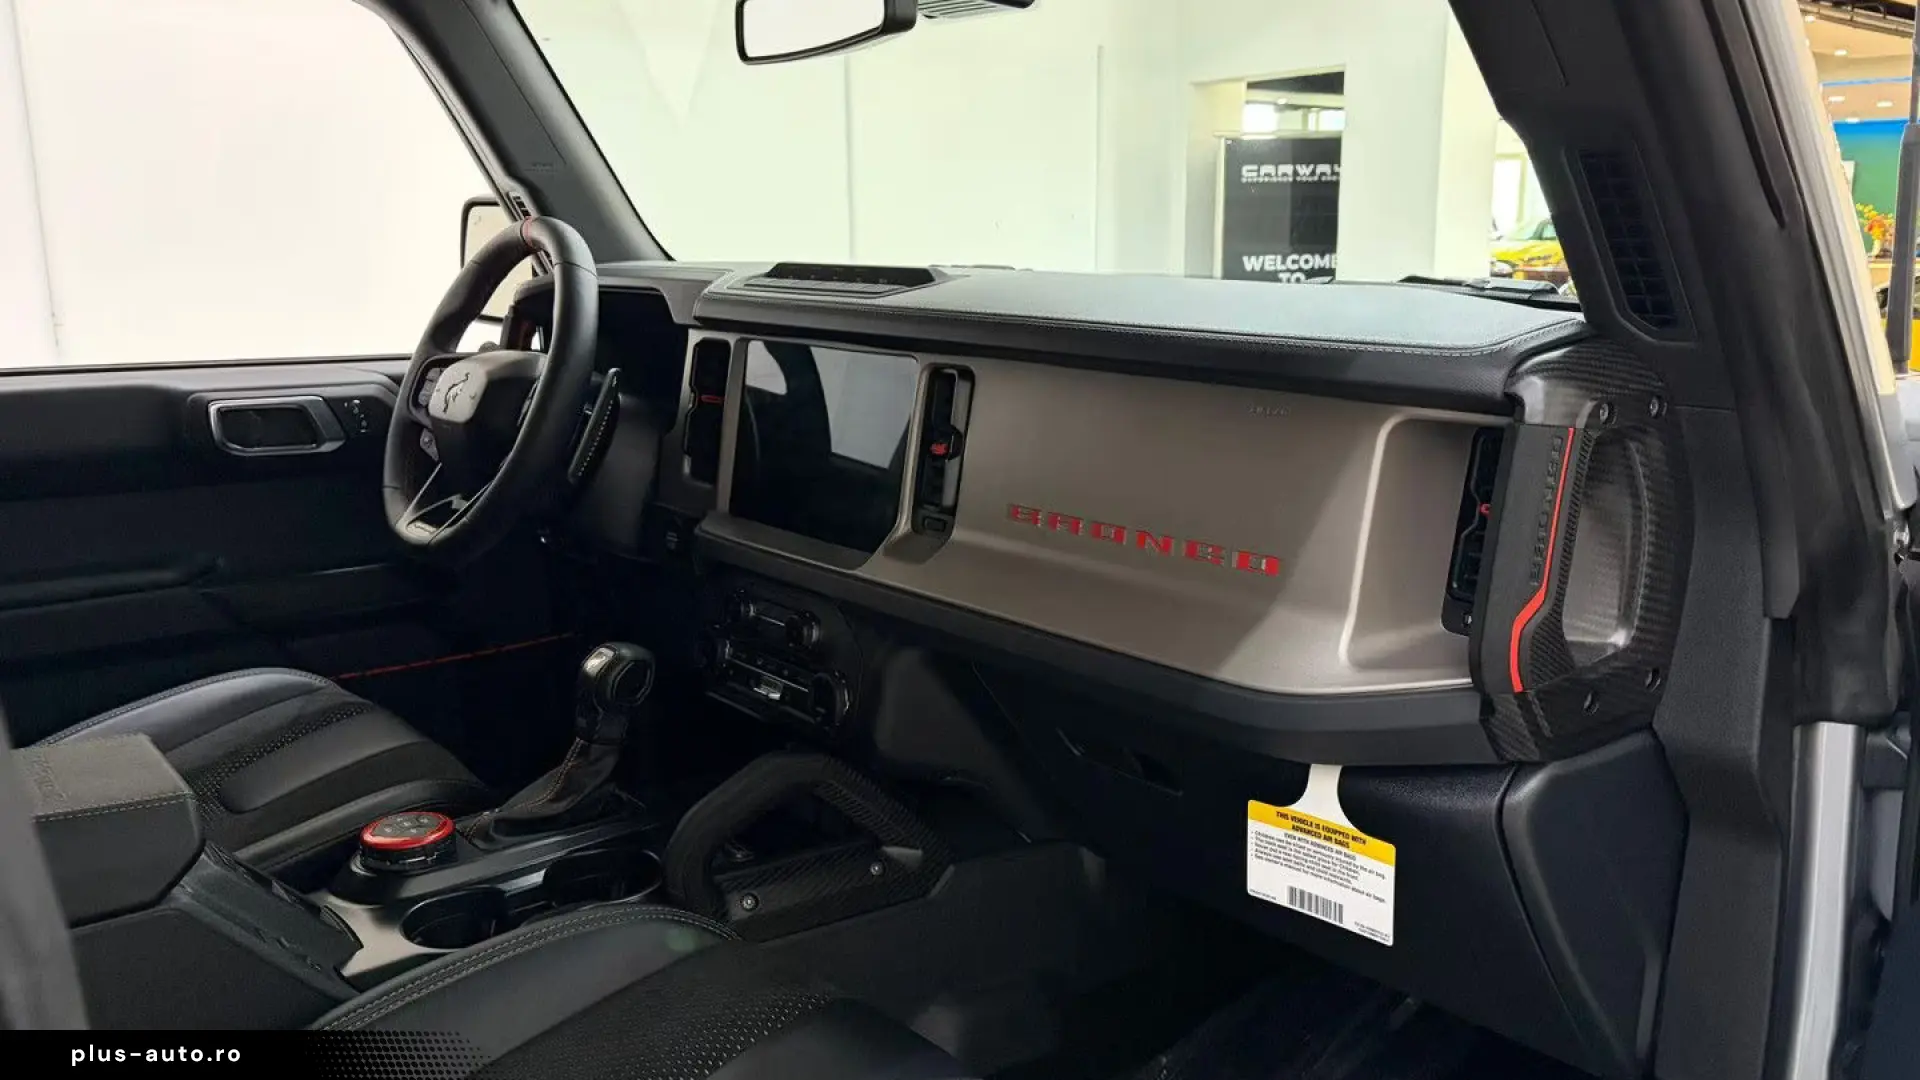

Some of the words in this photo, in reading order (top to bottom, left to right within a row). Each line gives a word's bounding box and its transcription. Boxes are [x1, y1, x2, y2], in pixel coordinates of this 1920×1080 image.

[1007, 503, 1280, 577] BRONCO
[1276, 810, 1288, 820] THIS
[1290, 814, 1312, 827] VEHICLE
[1322, 825, 1349, 839] EQUIPPED
[1351, 834, 1365, 845] WITH
[1292, 824, 1320, 838] ADVANCED
[1323, 834, 1332, 842] AIR
[1334, 838, 1349, 848] BAGS
